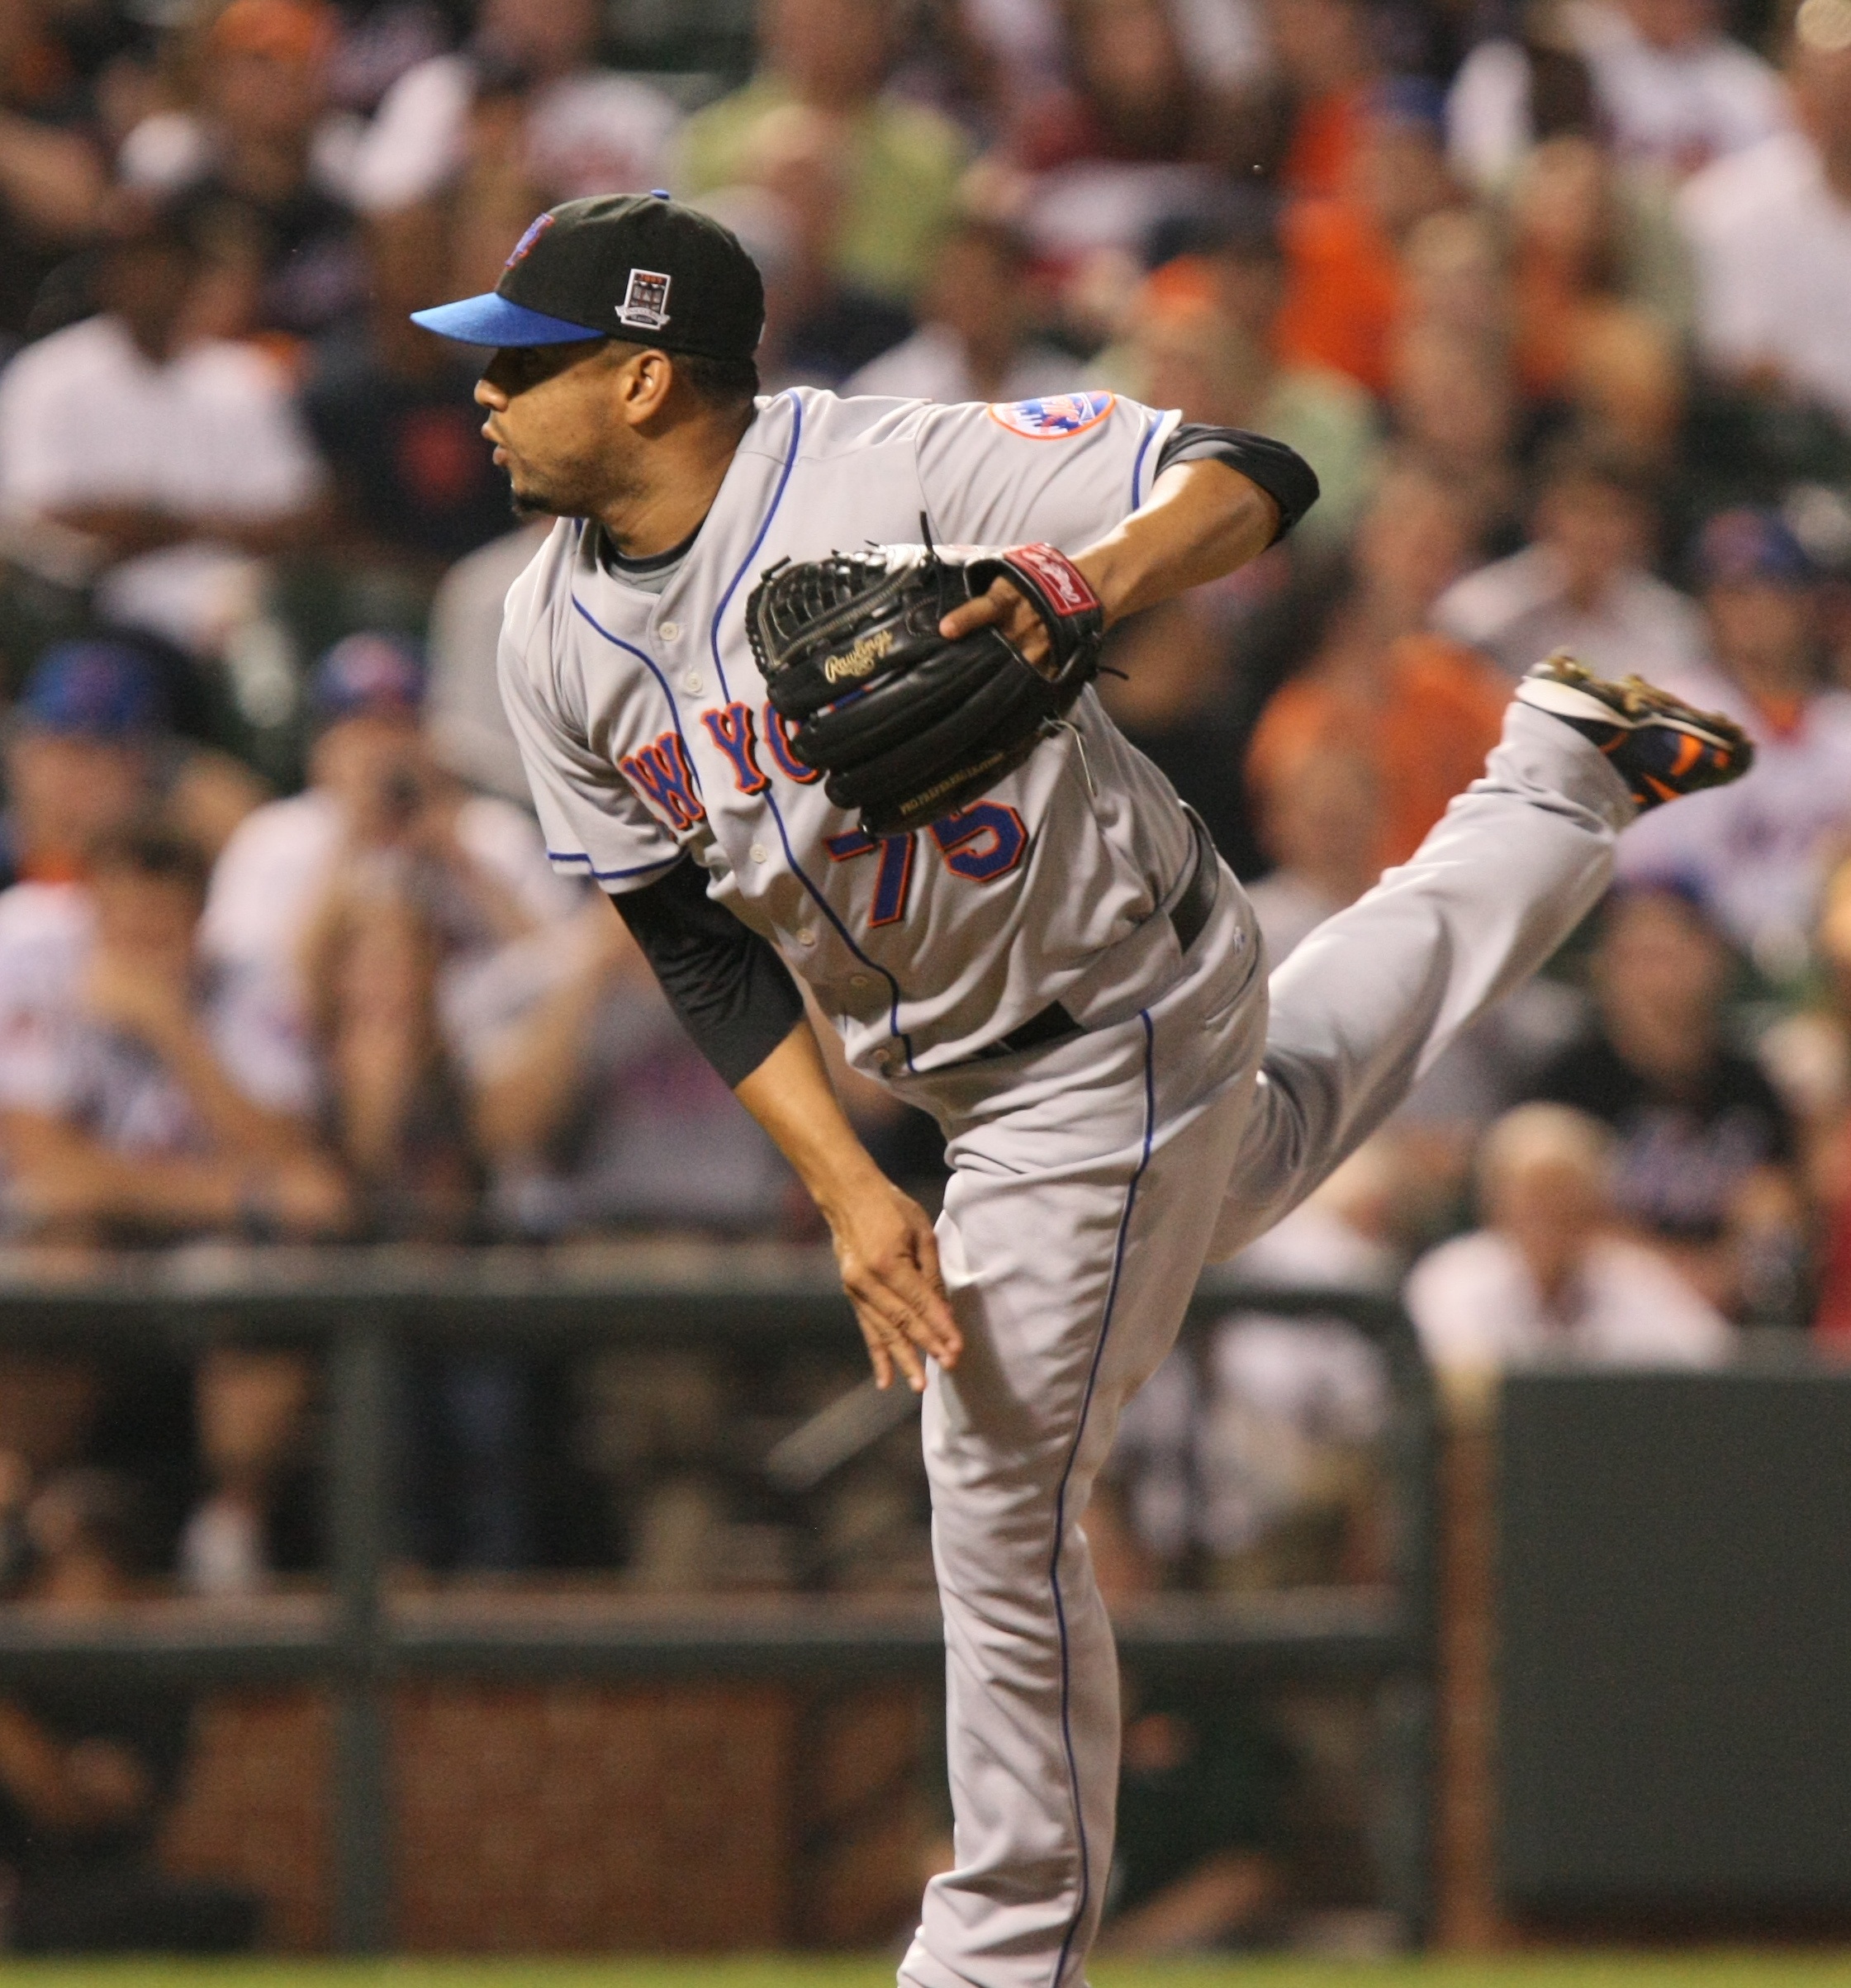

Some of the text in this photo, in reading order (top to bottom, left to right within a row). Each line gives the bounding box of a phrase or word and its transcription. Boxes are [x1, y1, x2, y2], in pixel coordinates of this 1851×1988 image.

[824, 629, 893, 685] Rawlings
[619, 731, 707, 832] W
[700, 701, 820, 795] YO
[823, 798, 1028, 928] 75
